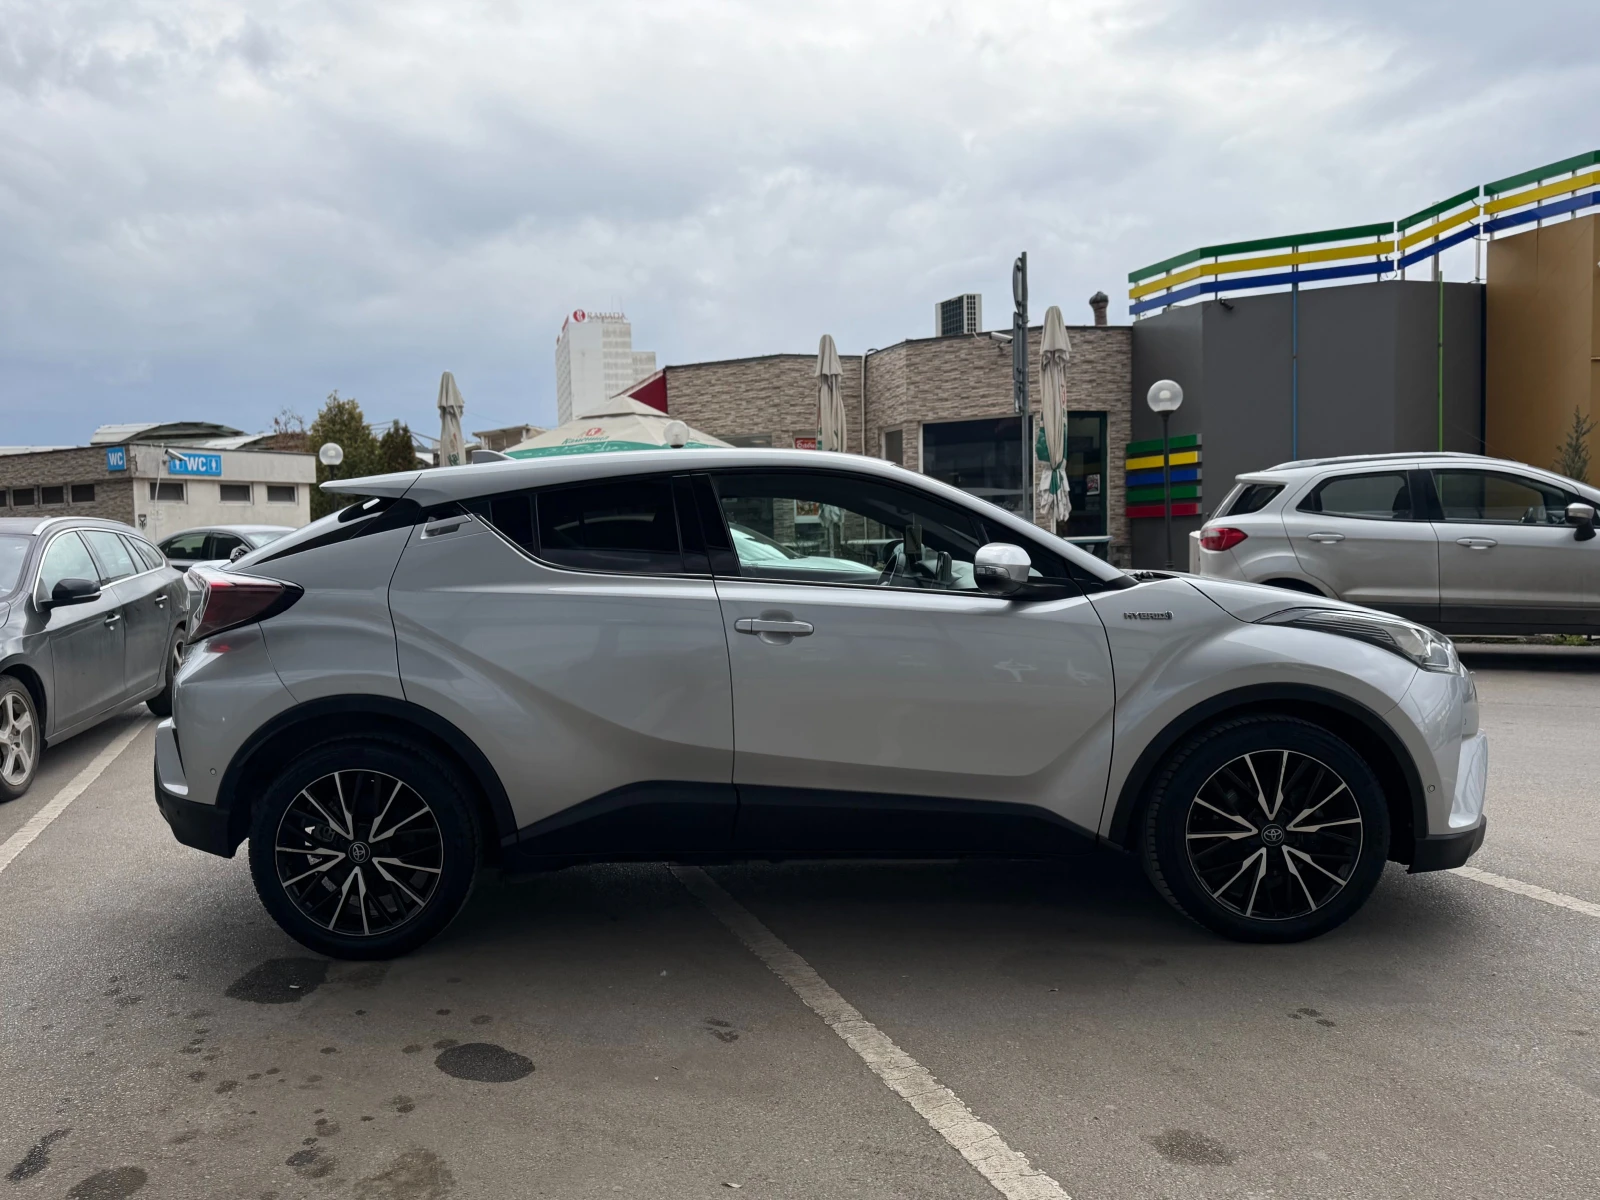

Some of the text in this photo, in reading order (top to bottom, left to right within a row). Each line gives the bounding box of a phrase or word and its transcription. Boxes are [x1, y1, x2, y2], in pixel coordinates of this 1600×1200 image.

[587, 311, 628, 320] RAMADA
[108, 452, 123, 466] WC
[186, 456, 207, 471] WC
[1123, 611, 1167, 620] HYBRID
